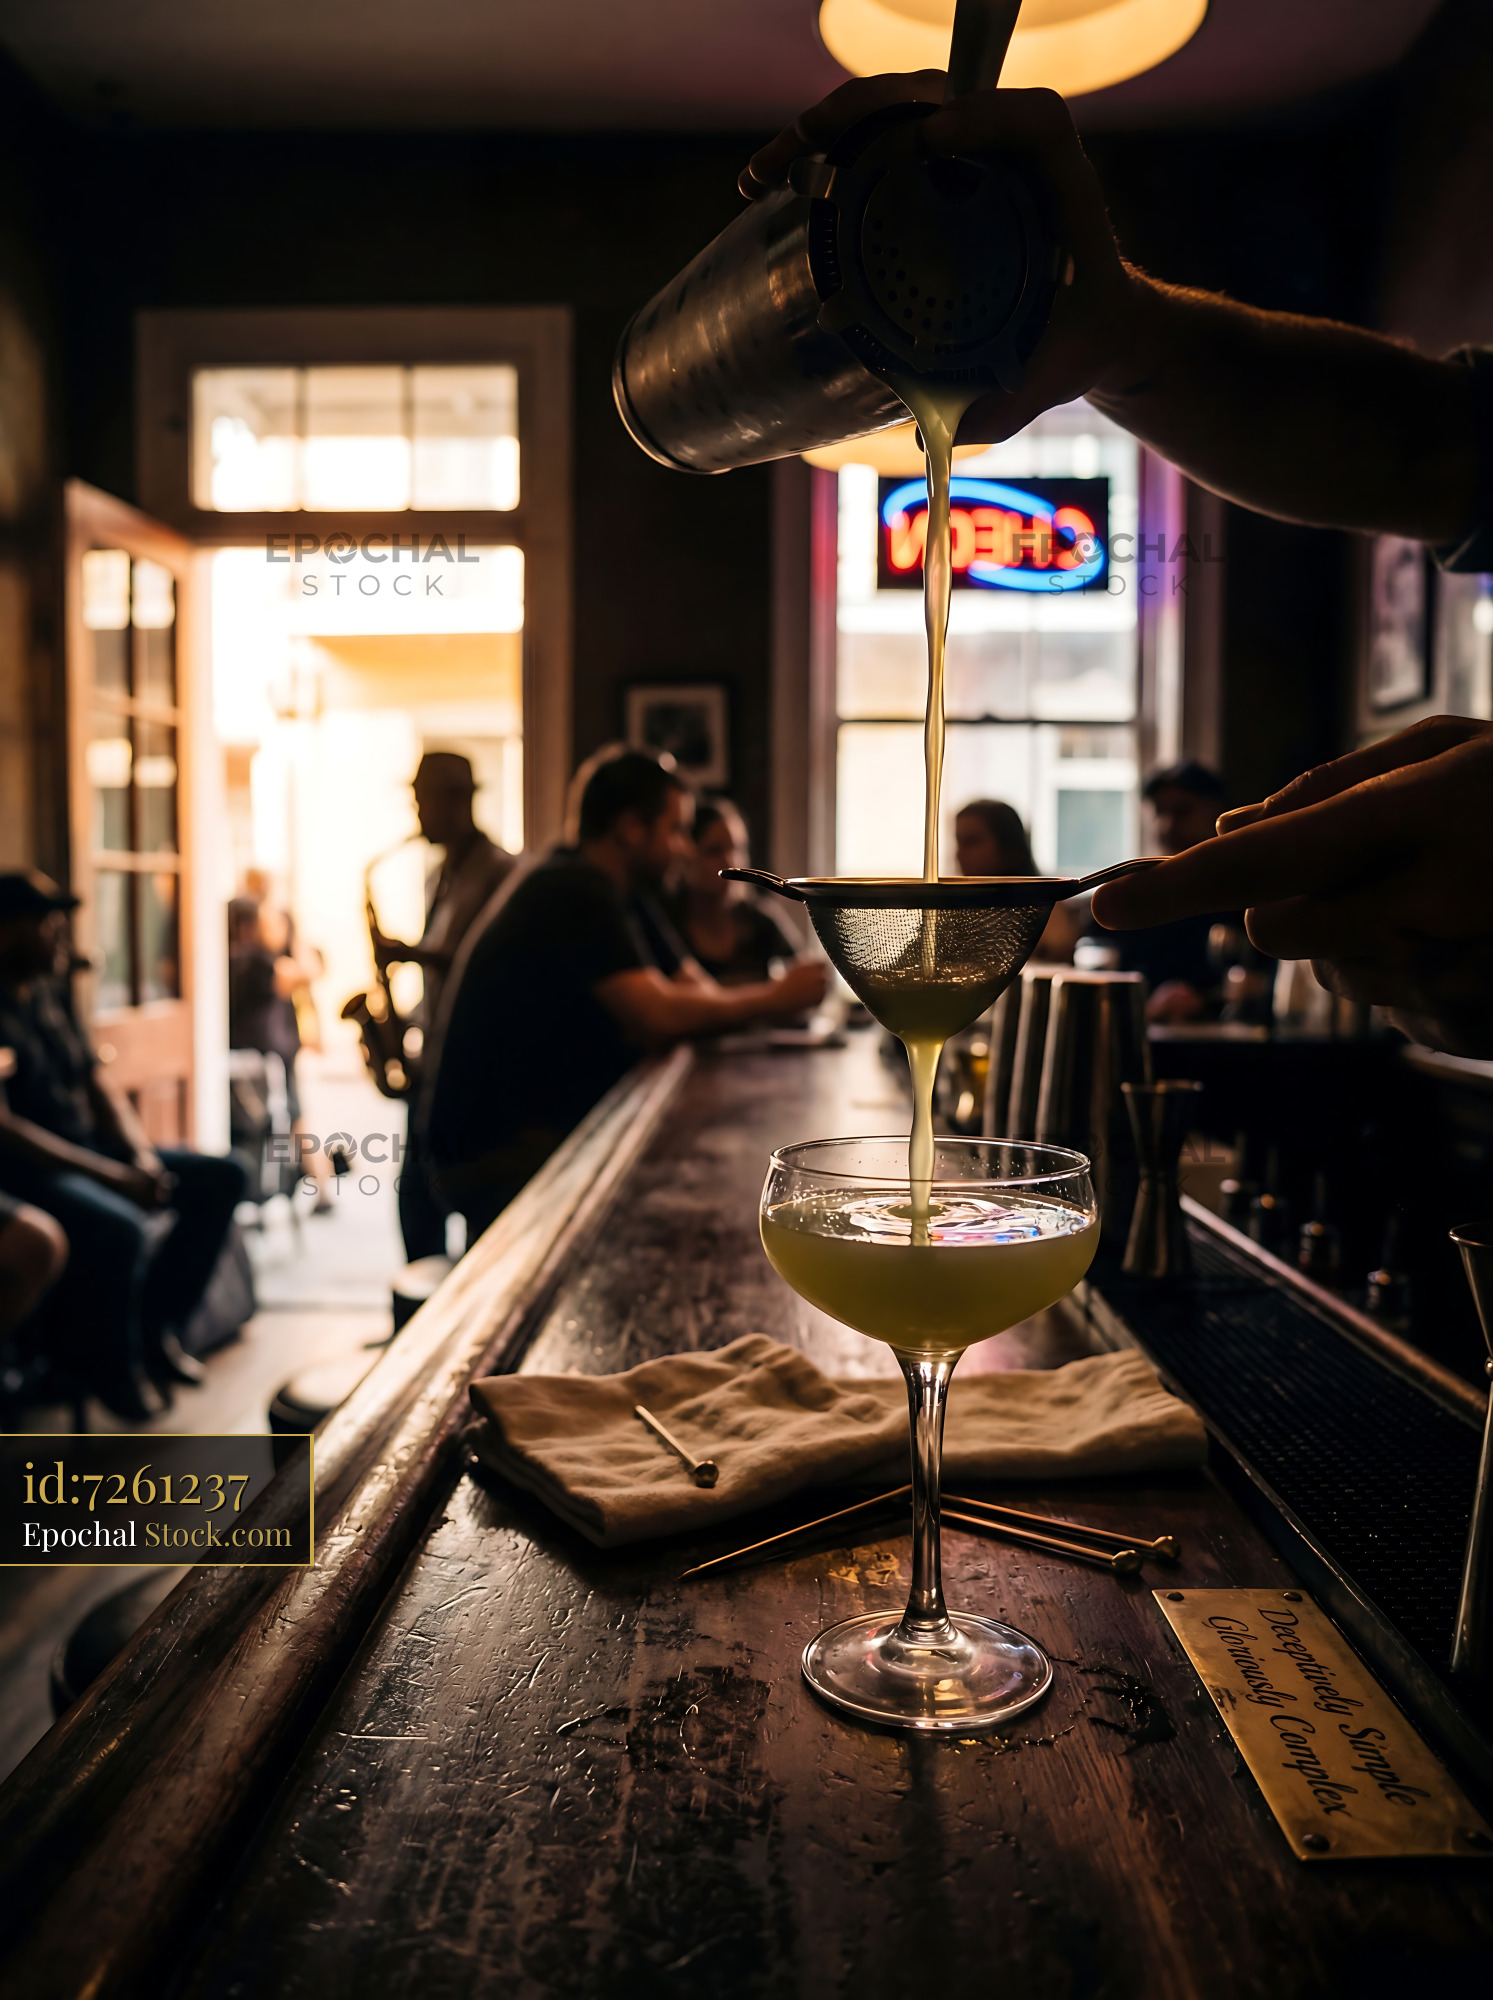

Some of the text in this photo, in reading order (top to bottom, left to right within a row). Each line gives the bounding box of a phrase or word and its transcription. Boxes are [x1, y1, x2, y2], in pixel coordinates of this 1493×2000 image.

[1201, 1616, 1358, 1818] Gloriously Complex
[1257, 1608, 1431, 1806] Deceptively Simple
